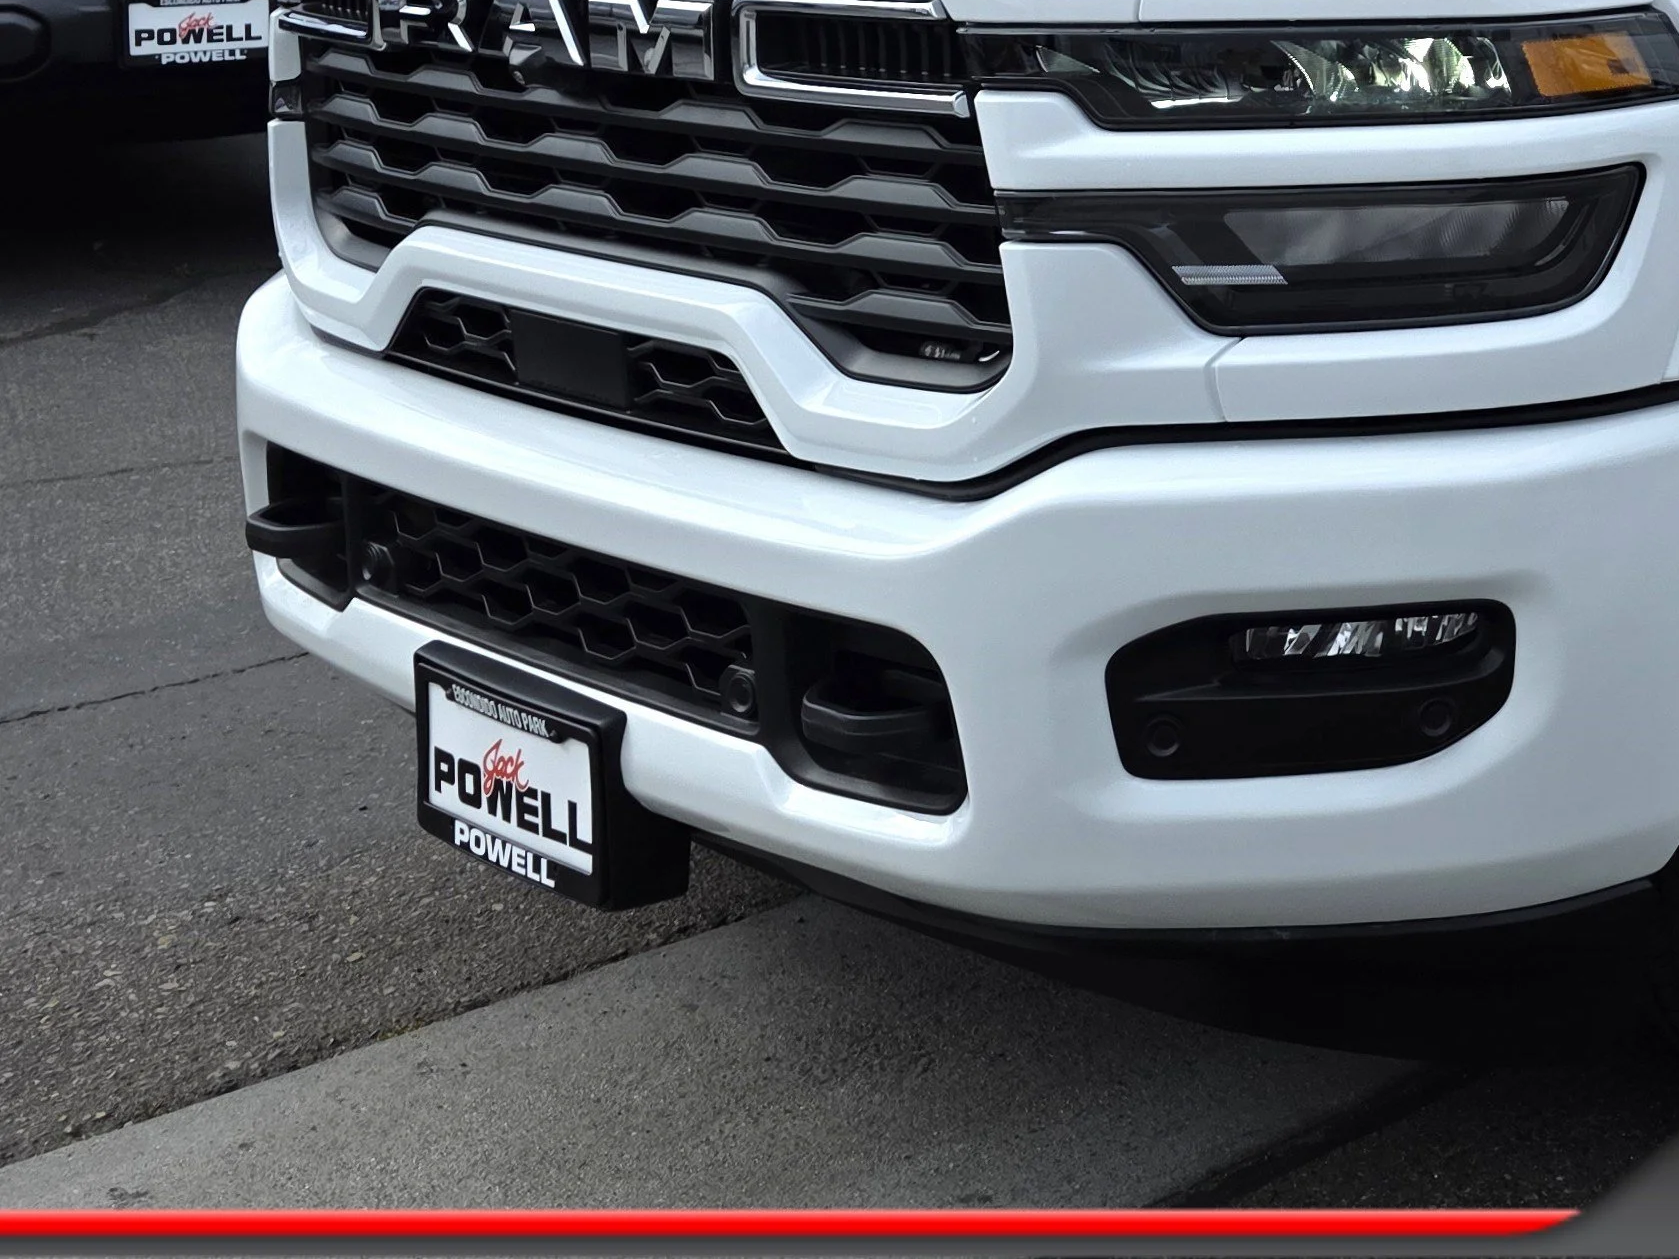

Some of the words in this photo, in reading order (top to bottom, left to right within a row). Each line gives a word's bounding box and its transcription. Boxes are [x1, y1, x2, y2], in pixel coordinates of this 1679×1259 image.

[135, 23, 262, 47] POWELL
[178, 12, 213, 40] Jack
[161, 48, 247, 65] POWELL
[497, 703, 522, 728] AUTO
[521, 712, 549, 737] PARK
[483, 738, 529, 797] Jack
[434, 746, 593, 855] POWELL
[454, 822, 555, 888] POWELL
